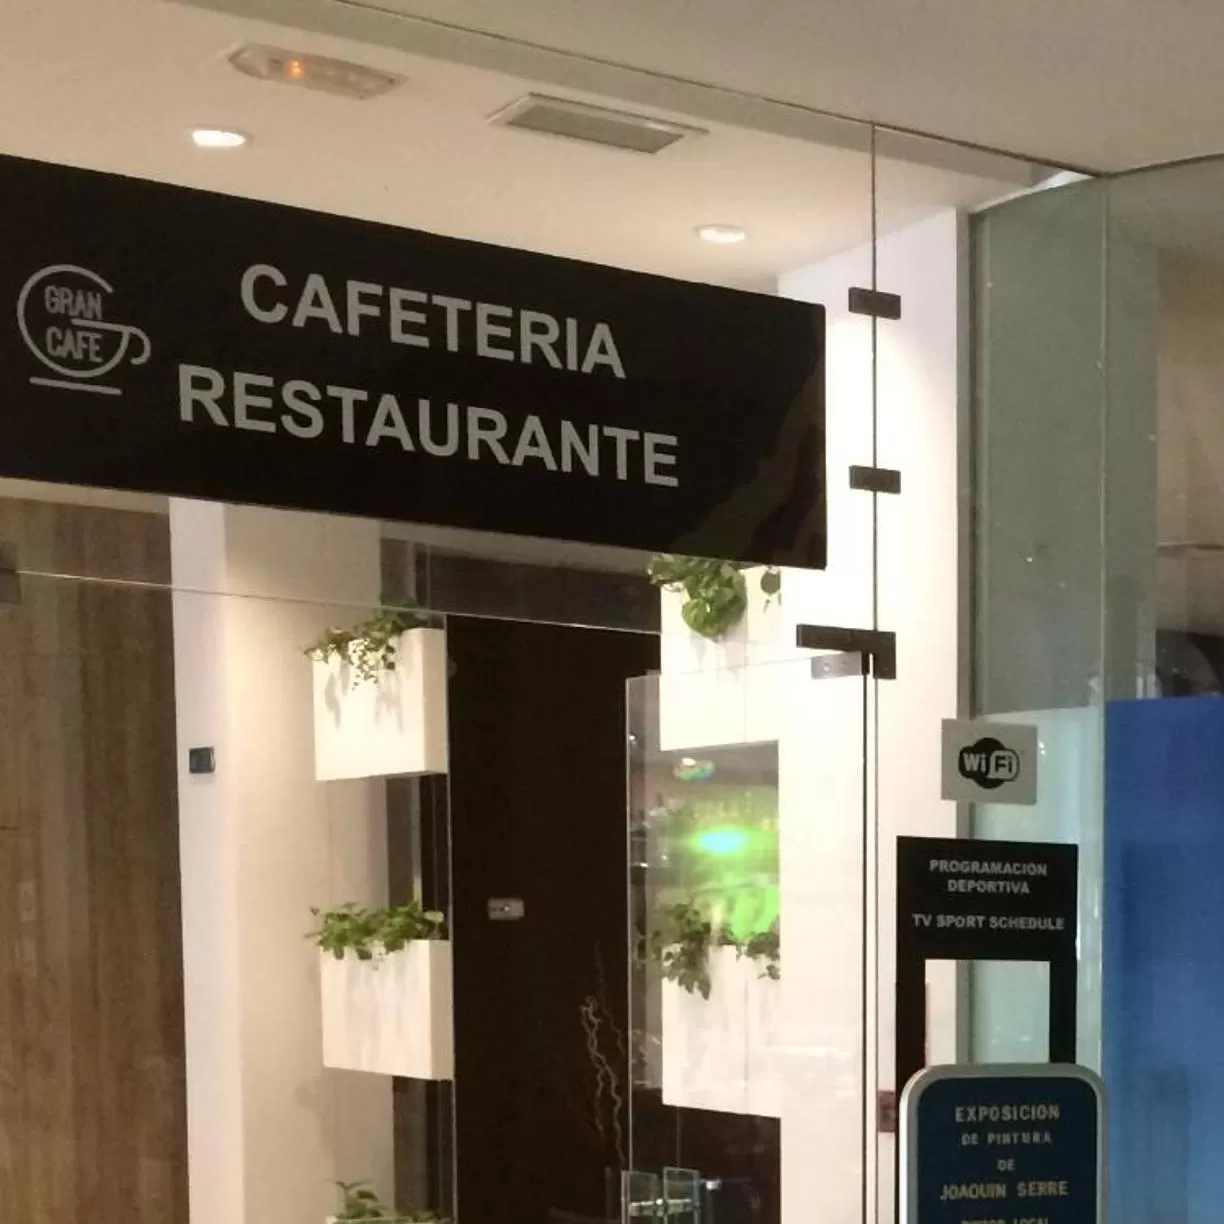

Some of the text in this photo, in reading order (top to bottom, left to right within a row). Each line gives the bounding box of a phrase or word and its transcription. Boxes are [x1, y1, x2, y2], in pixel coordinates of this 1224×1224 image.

[44, 285, 103, 319] GRAN
[240, 263, 627, 379] CAFETERIA
[46, 325, 104, 363] CAFE
[178, 364, 680, 488] RESTAURANTE
[948, 879, 1030, 894] DEPORTIVA
[912, 913, 1065, 931] TV SPORT SCHEDULE
[955, 1103, 1060, 1123] EXPOSICION
[961, 1130, 1053, 1147] DE PINTURA
[996, 1158, 1016, 1172] DE
[940, 1182, 1007, 1201] JOAQUIN
